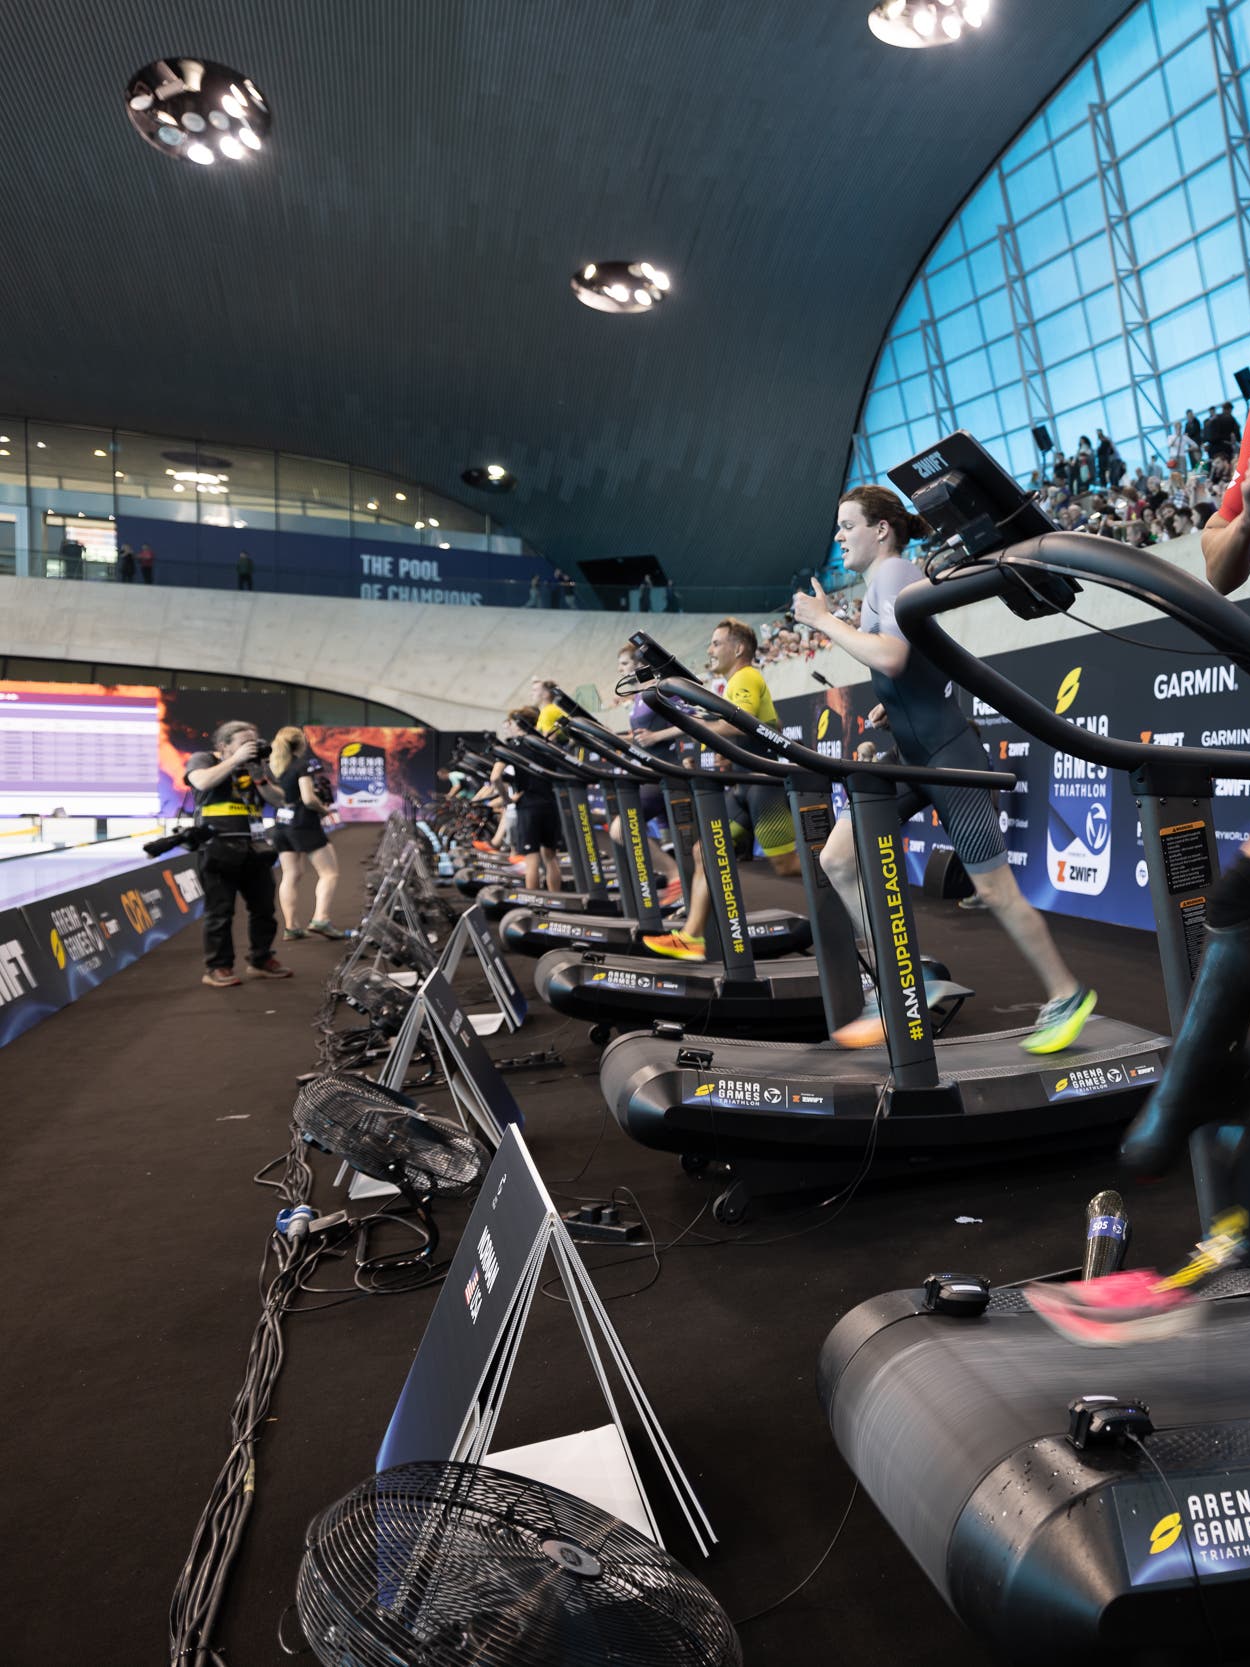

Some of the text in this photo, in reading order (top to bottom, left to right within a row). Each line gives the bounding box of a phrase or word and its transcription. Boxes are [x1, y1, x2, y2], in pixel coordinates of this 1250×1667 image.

[911, 451, 949, 479] ZWIFT
[360, 554, 442, 582] THE POOL
[756, 723, 792, 749] ZWIFT
[1054, 783, 1107, 798] TRIATHLON
[1069, 865, 1098, 884] ZWIFT
[710, 818, 745, 953] #IAMSUPERLEAGUE
[877, 834, 925, 1041] #IAMSUPERLEAGUE
[1069, 1067, 1102, 1081] ARENA
[1072, 1076, 1106, 1089] GAMES
[718, 1080, 760, 1091] ARENA
[718, 1089, 760, 1101] GAMES
[719, 1098, 760, 1107] TRIATHLON
